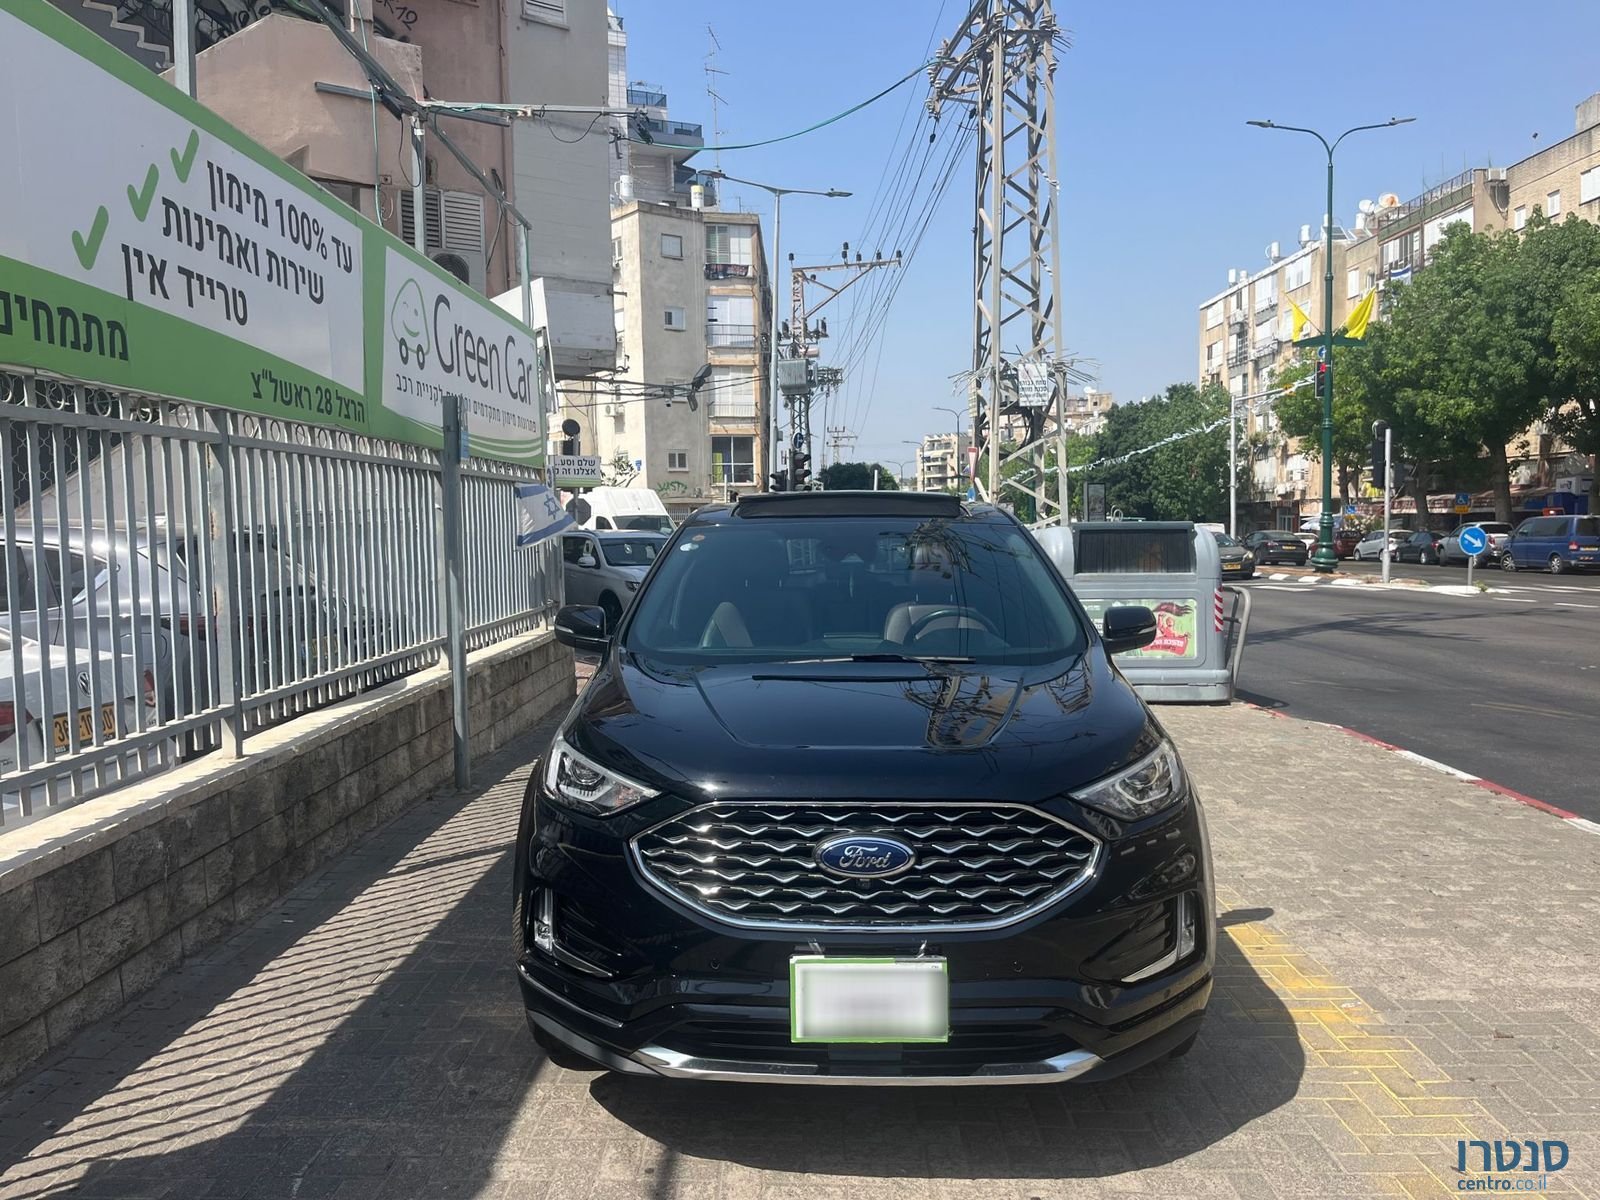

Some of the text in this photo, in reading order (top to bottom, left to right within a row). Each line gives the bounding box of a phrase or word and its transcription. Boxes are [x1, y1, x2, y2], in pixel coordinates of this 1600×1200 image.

[206, 159, 353, 274] עד 100% מימון
[161, 195, 324, 305] שירות ואמינות
[120, 243, 248, 326] טרייד אין
[433, 293, 533, 406] Green Car
[396, 373, 413, 395] רכב
[315, 385, 333, 416] 28
[335, 389, 365, 423] הרצל
[573, 467, 596, 476] אצלנו
[577, 458, 596, 467] שלם
[839, 845, 892, 868] Ford
